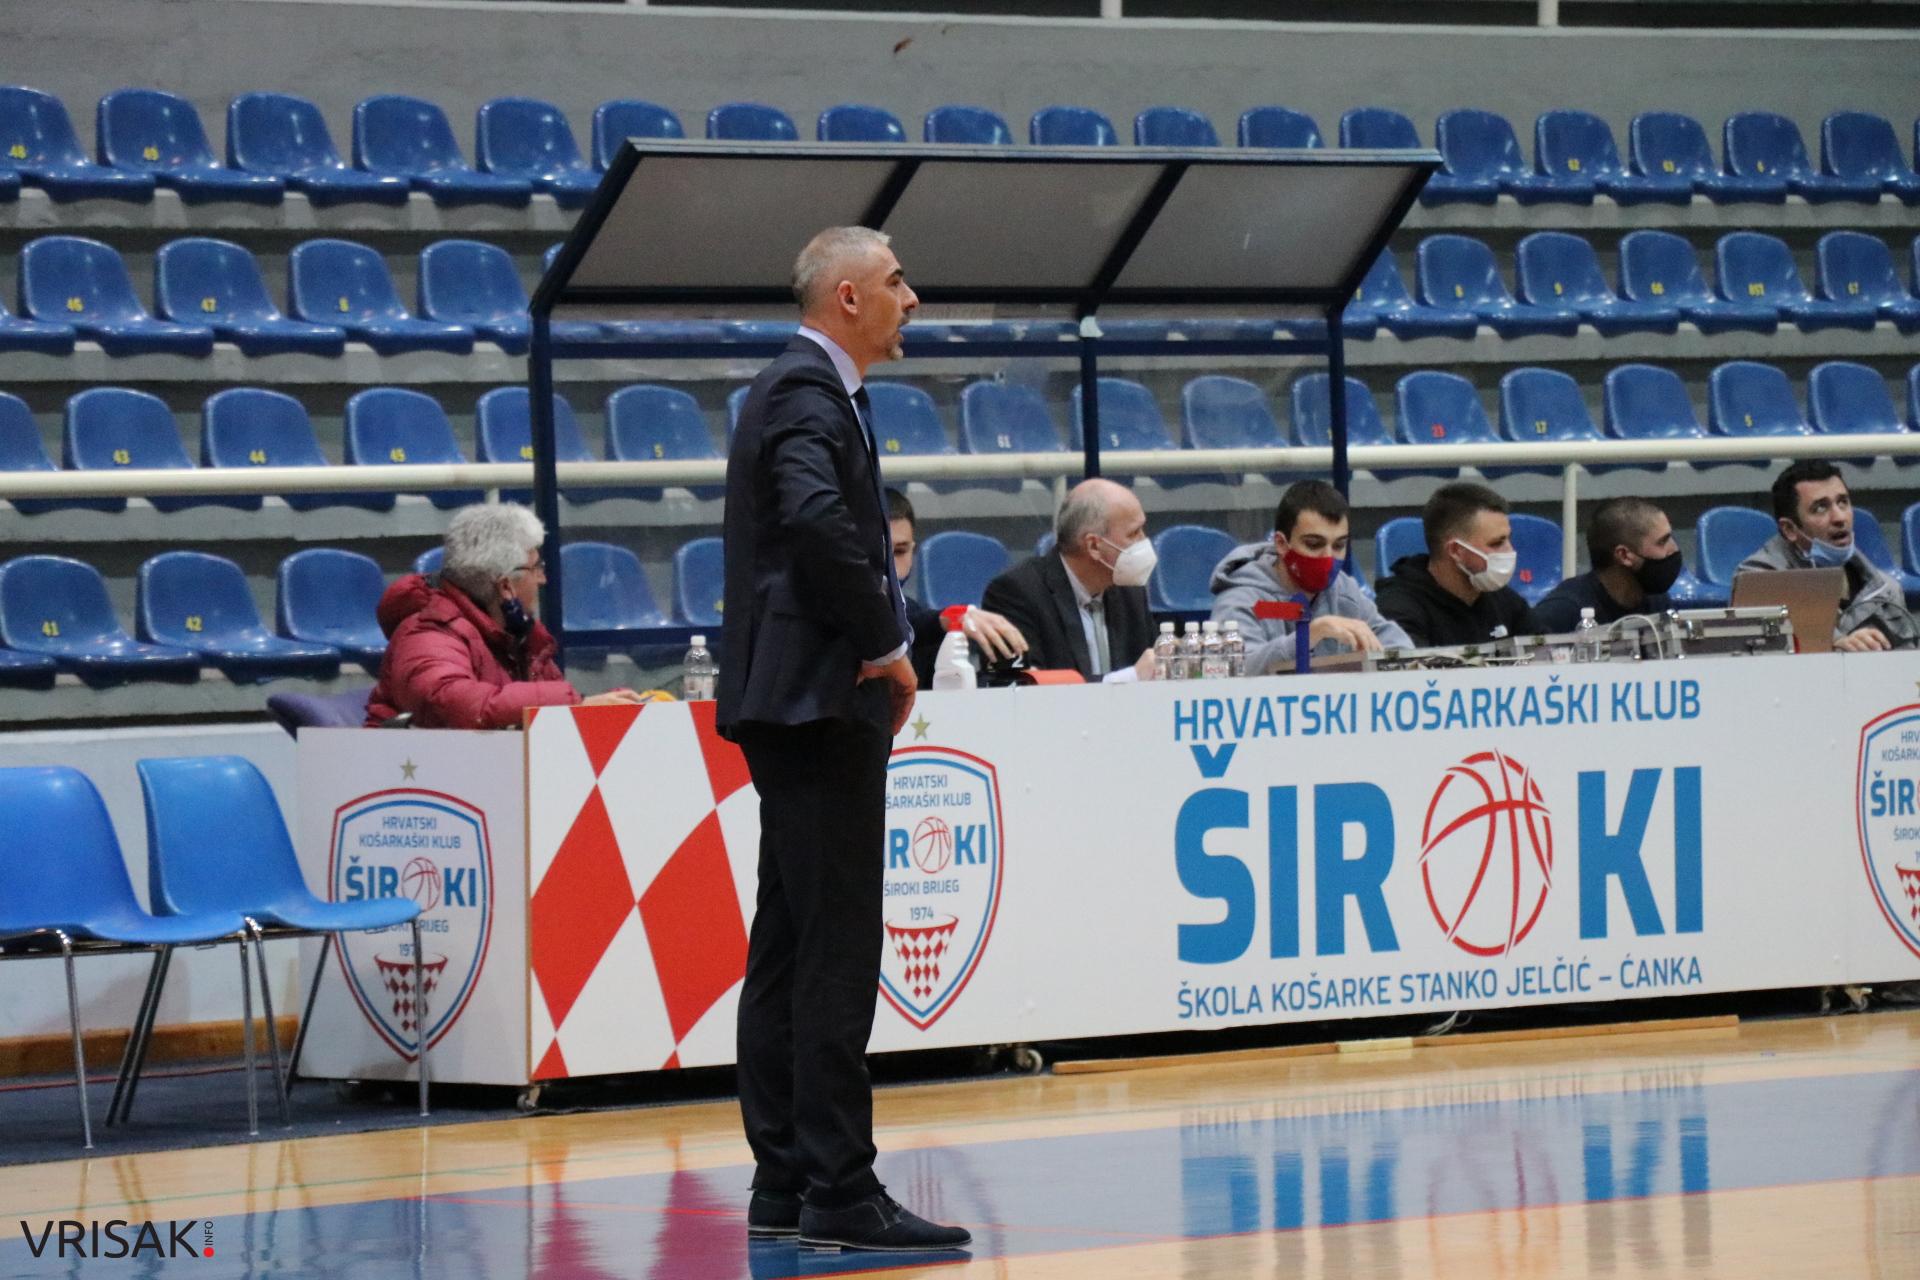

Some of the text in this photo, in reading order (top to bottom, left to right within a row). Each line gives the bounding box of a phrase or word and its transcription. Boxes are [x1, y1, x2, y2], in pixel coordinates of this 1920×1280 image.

[1173, 675, 1700, 742] HRVATSKI KOŠARKAŠKI KLUB
[893, 774, 948, 790] HRVATSKI
[885, 792, 972, 810] ŠARKAŠKI KLUB
[382, 816, 437, 830] HRVATSKI
[359, 833, 461, 849] KOŠARKAŠKI KLUB
[923, 879, 960, 895] BRIJEG
[910, 906, 934, 921] 1974
[416, 919, 449, 933] RIJEG
[1178, 980, 1263, 1020] ŠKOLA
[1272, 970, 1392, 1012] KOŠARKE
[1400, 967, 1498, 1003] STANKO
[1506, 955, 1592, 997] JELČIĆ
[1620, 957, 1703, 989] ĆANKA
